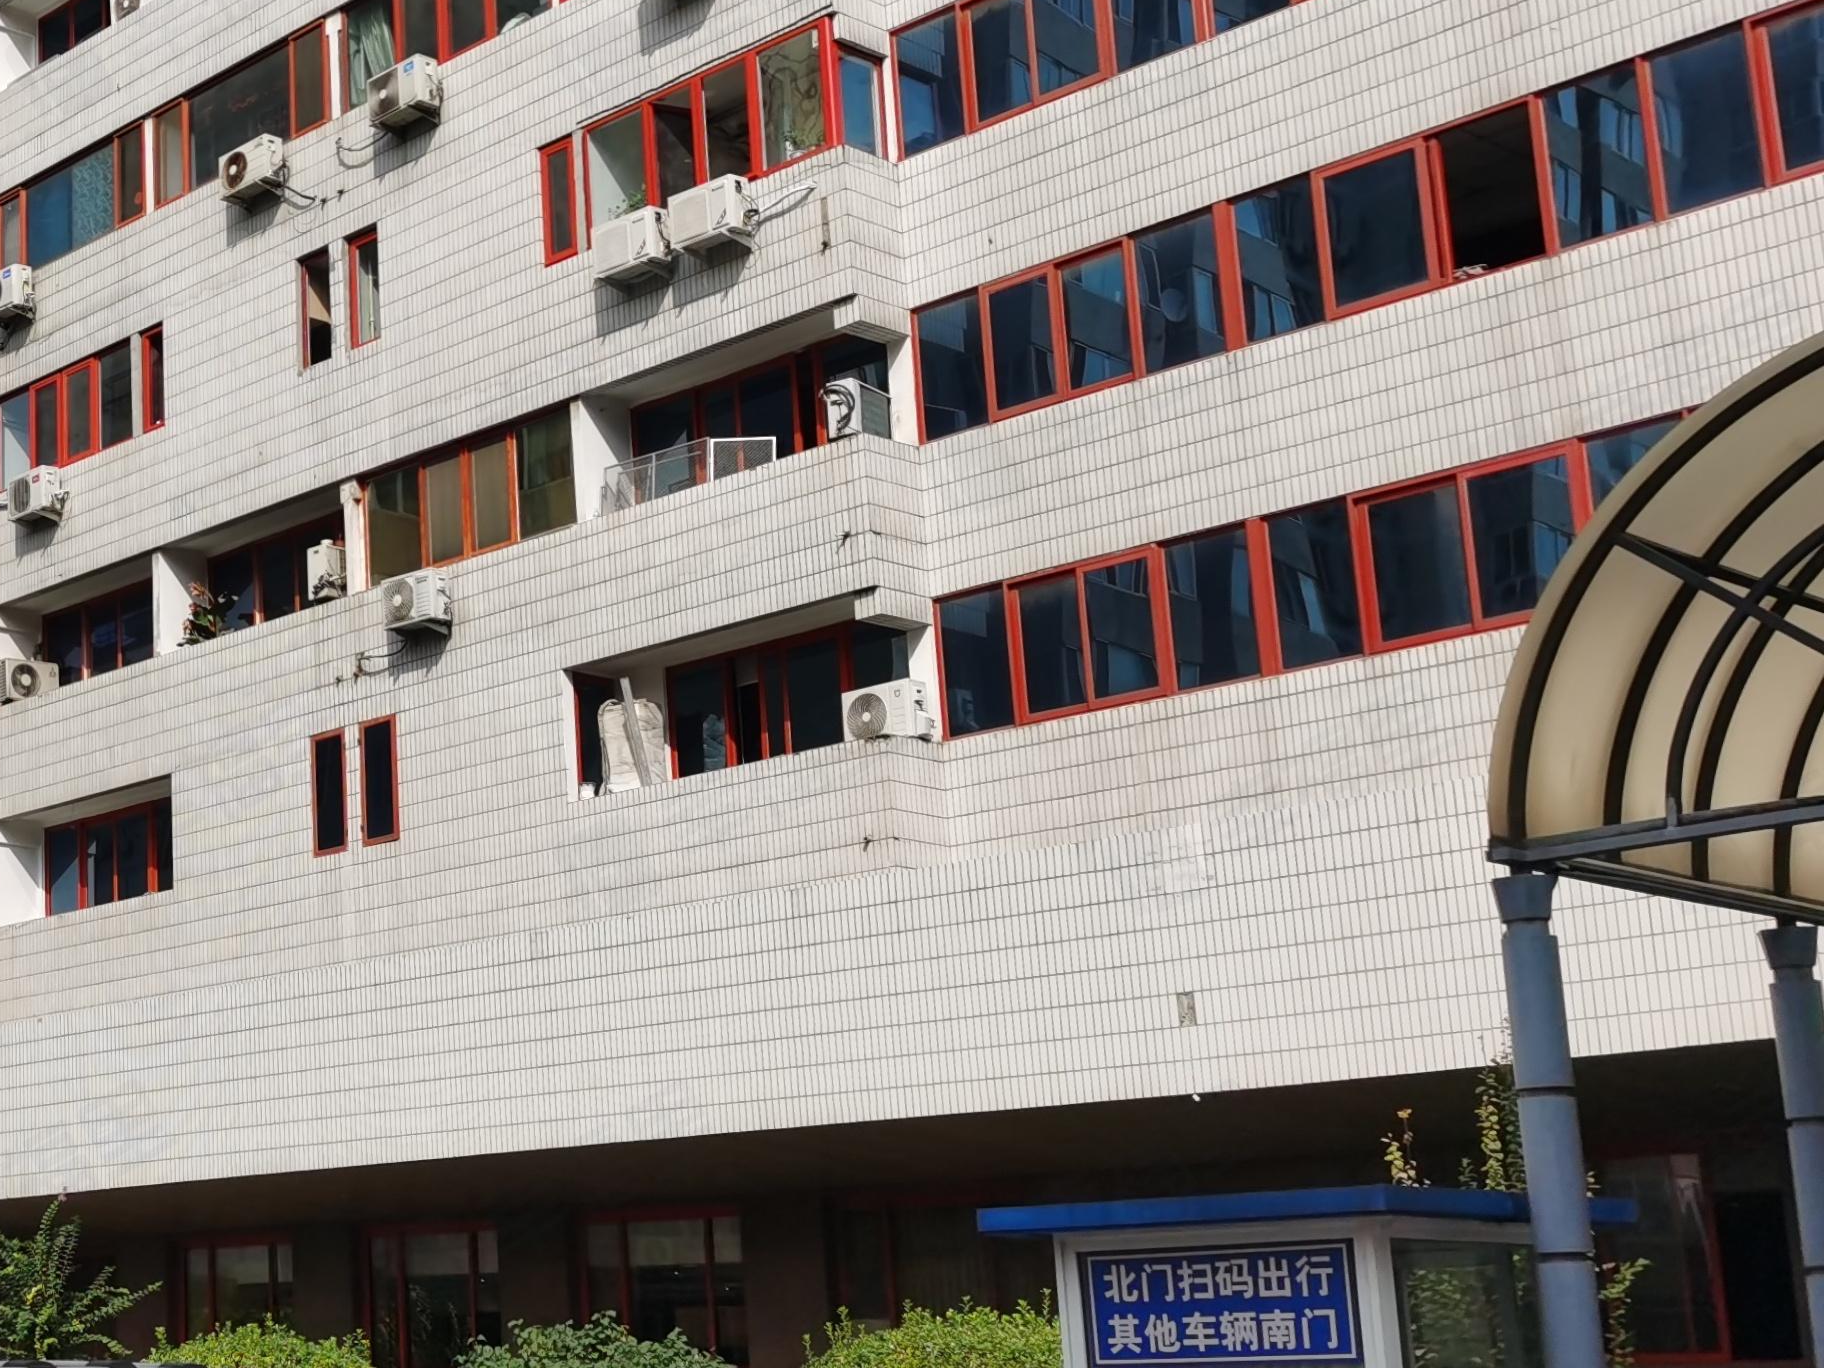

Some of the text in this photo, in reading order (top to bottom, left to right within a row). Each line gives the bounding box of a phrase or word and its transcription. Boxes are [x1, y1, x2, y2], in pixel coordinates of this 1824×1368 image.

[1103, 1255, 1334, 1304] 北门扫码出行
[1107, 1308, 1339, 1355] 其他车辆南门
